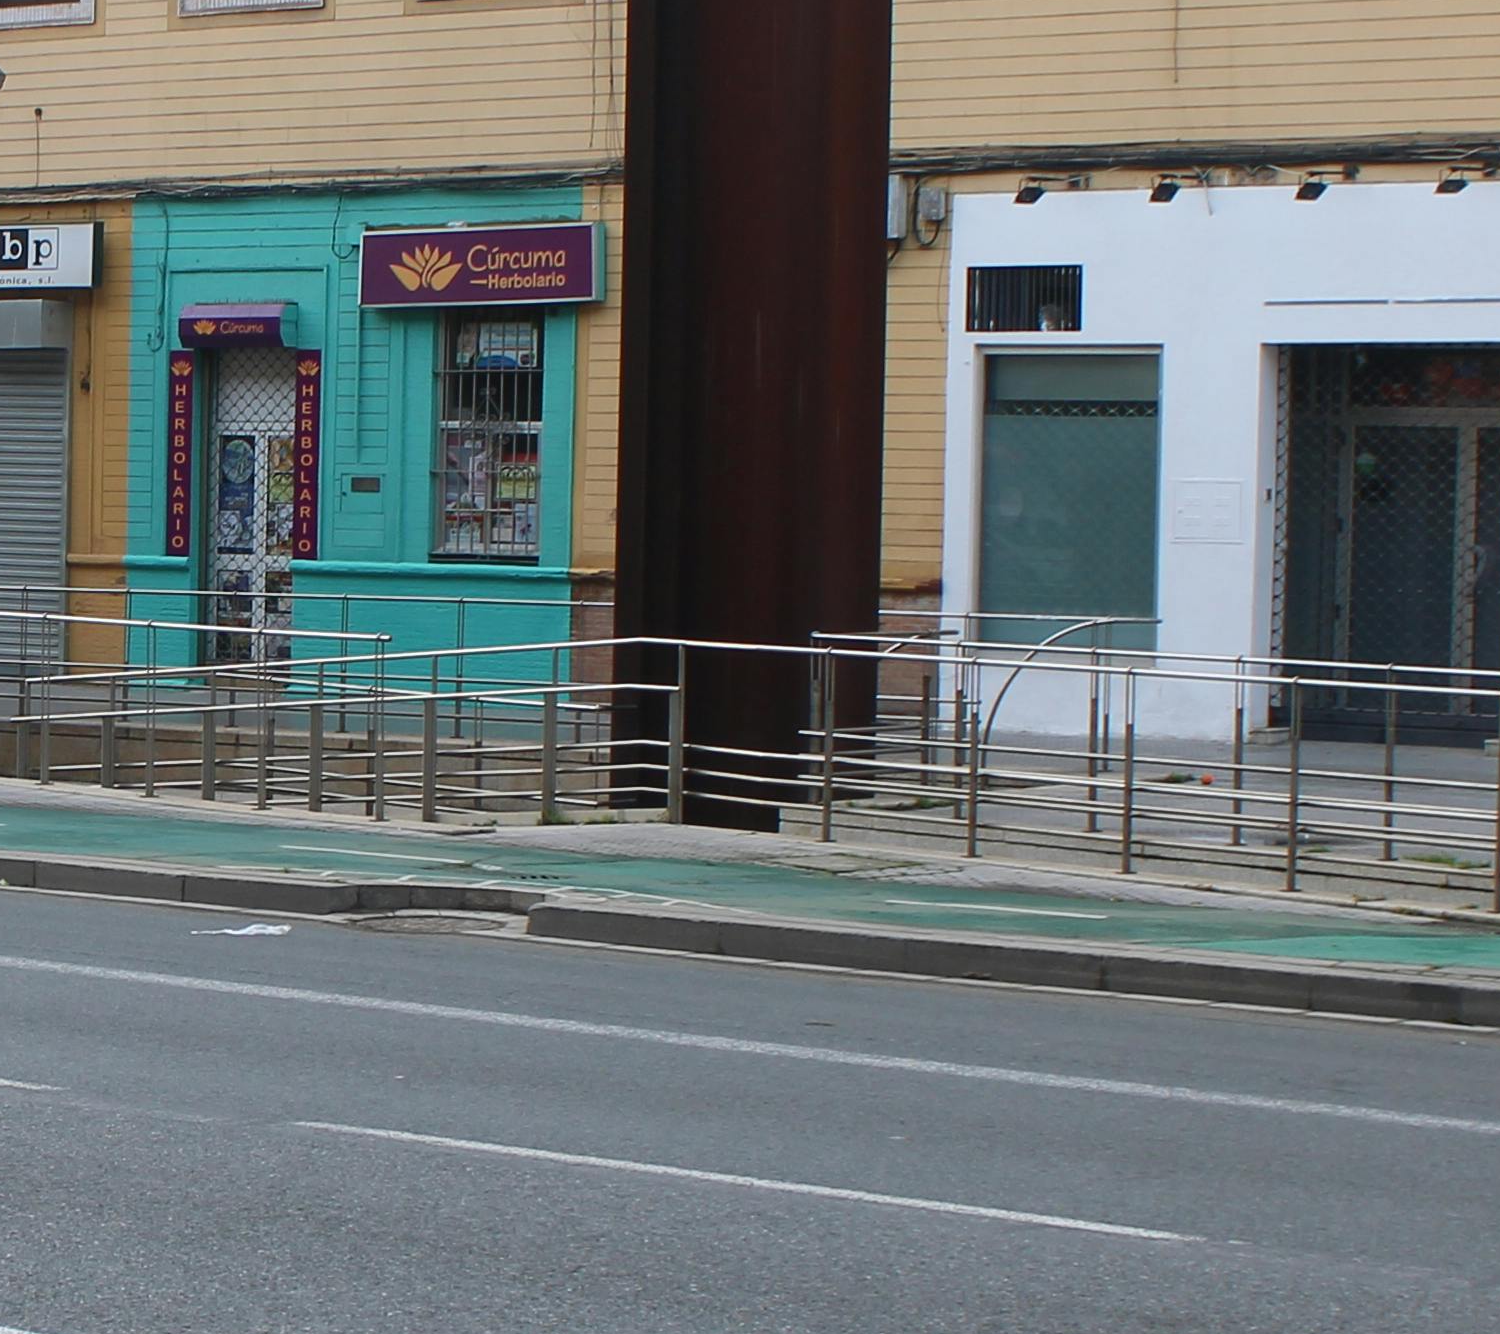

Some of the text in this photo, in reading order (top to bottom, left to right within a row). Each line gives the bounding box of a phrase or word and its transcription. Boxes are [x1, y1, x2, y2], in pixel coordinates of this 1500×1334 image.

[467, 244, 566, 272] Cúrcuma
[488, 272, 566, 290] Herbolario
[219, 320, 265, 334] Cúrcuma
[171, 384, 187, 549] HERBOLARIO
[298, 384, 314, 553] HERBOLARIO
